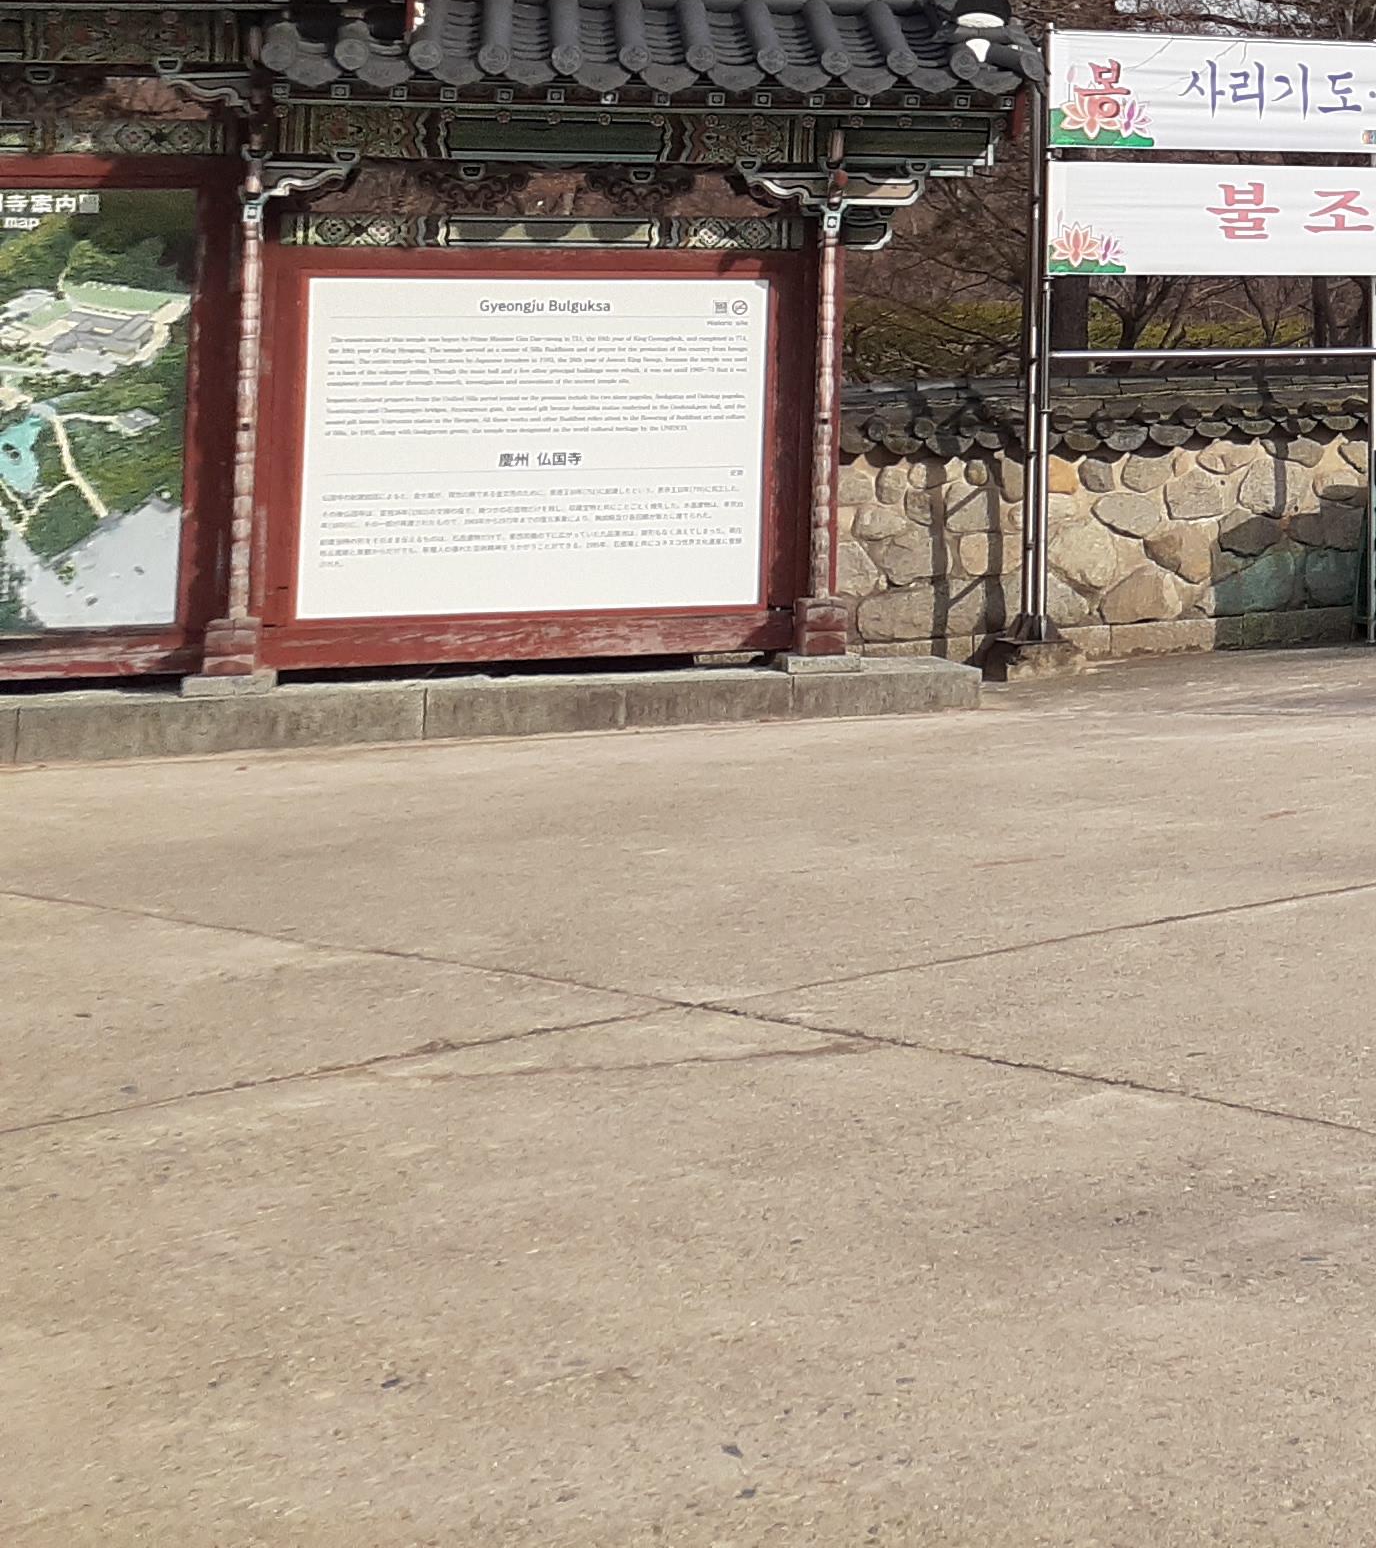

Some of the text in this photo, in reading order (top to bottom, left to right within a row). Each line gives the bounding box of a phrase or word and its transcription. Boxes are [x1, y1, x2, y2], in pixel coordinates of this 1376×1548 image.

[4, 217, 40, 230] map
[479, 299, 611, 313] Gyeongju Bulguksa
[537, 452, 582, 466] 仏国寺
